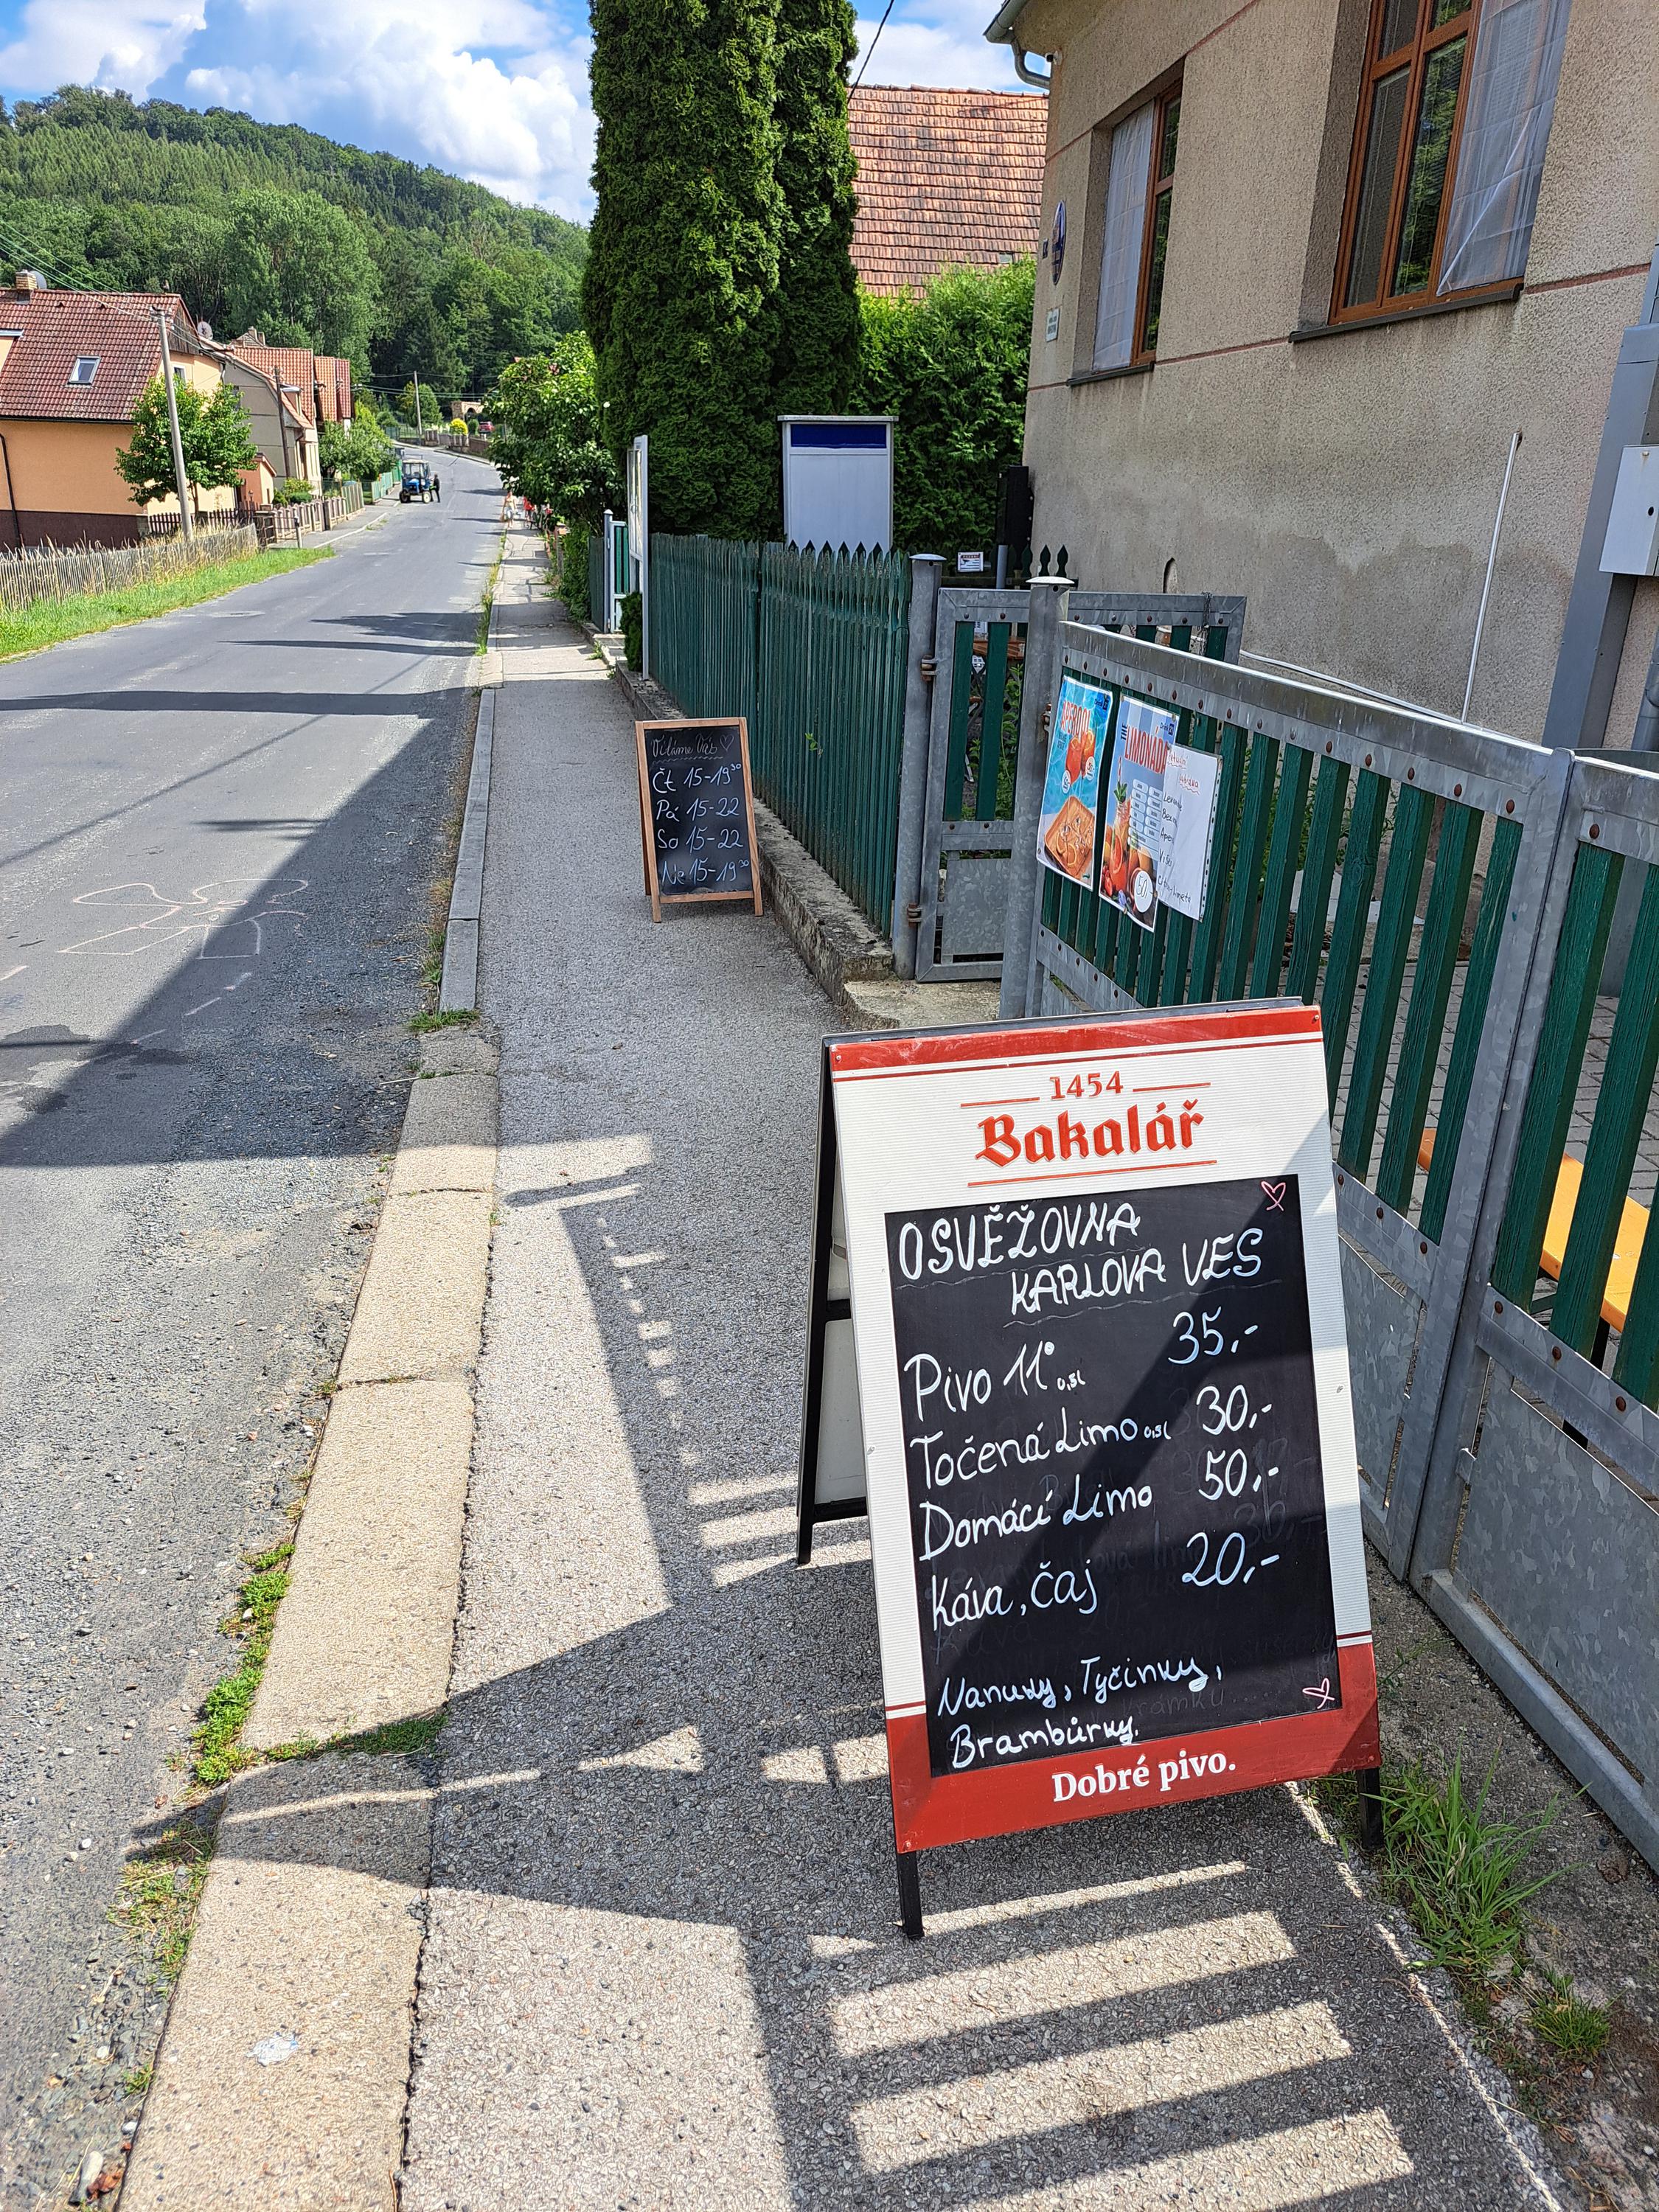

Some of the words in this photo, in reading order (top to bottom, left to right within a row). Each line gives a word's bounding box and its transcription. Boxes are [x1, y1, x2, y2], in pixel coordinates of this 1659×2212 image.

[696, 732, 718, 755] Vás
[1121, 723, 1129, 741] THE
[653, 767, 677, 794] Čt
[656, 799, 680, 823] Pá
[686, 796, 740, 822] 15-22
[658, 828, 679, 850] So
[686, 825, 744, 856] 15-22
[661, 860, 685, 886] Ne
[1049, 1070, 1124, 1100] 1454
[974, 1098, 1206, 1169] Bakalář
[899, 1202, 1142, 1281] OSVĚŽOVNA
[1011, 1248, 1167, 1316] KARLOVA
[1182, 1228, 1264, 1287] VES
[903, 1352, 992, 1422] Pivo
[1167, 1306, 1259, 1366] 35,-
[909, 1422, 1051, 1489] Točená
[1055, 1406, 1138, 1453] Limo
[1196, 1384, 1273, 1435] 30,-
[919, 1488, 1052, 1561] Domácí
[1062, 1473, 1153, 1526] Limo
[1198, 1447, 1280, 1501] 50,-
[1182, 1531, 1281, 1588] 20,-
[1051, 1753, 1150, 1803] Dobré
[1158, 1748, 1237, 1792] pivo.
